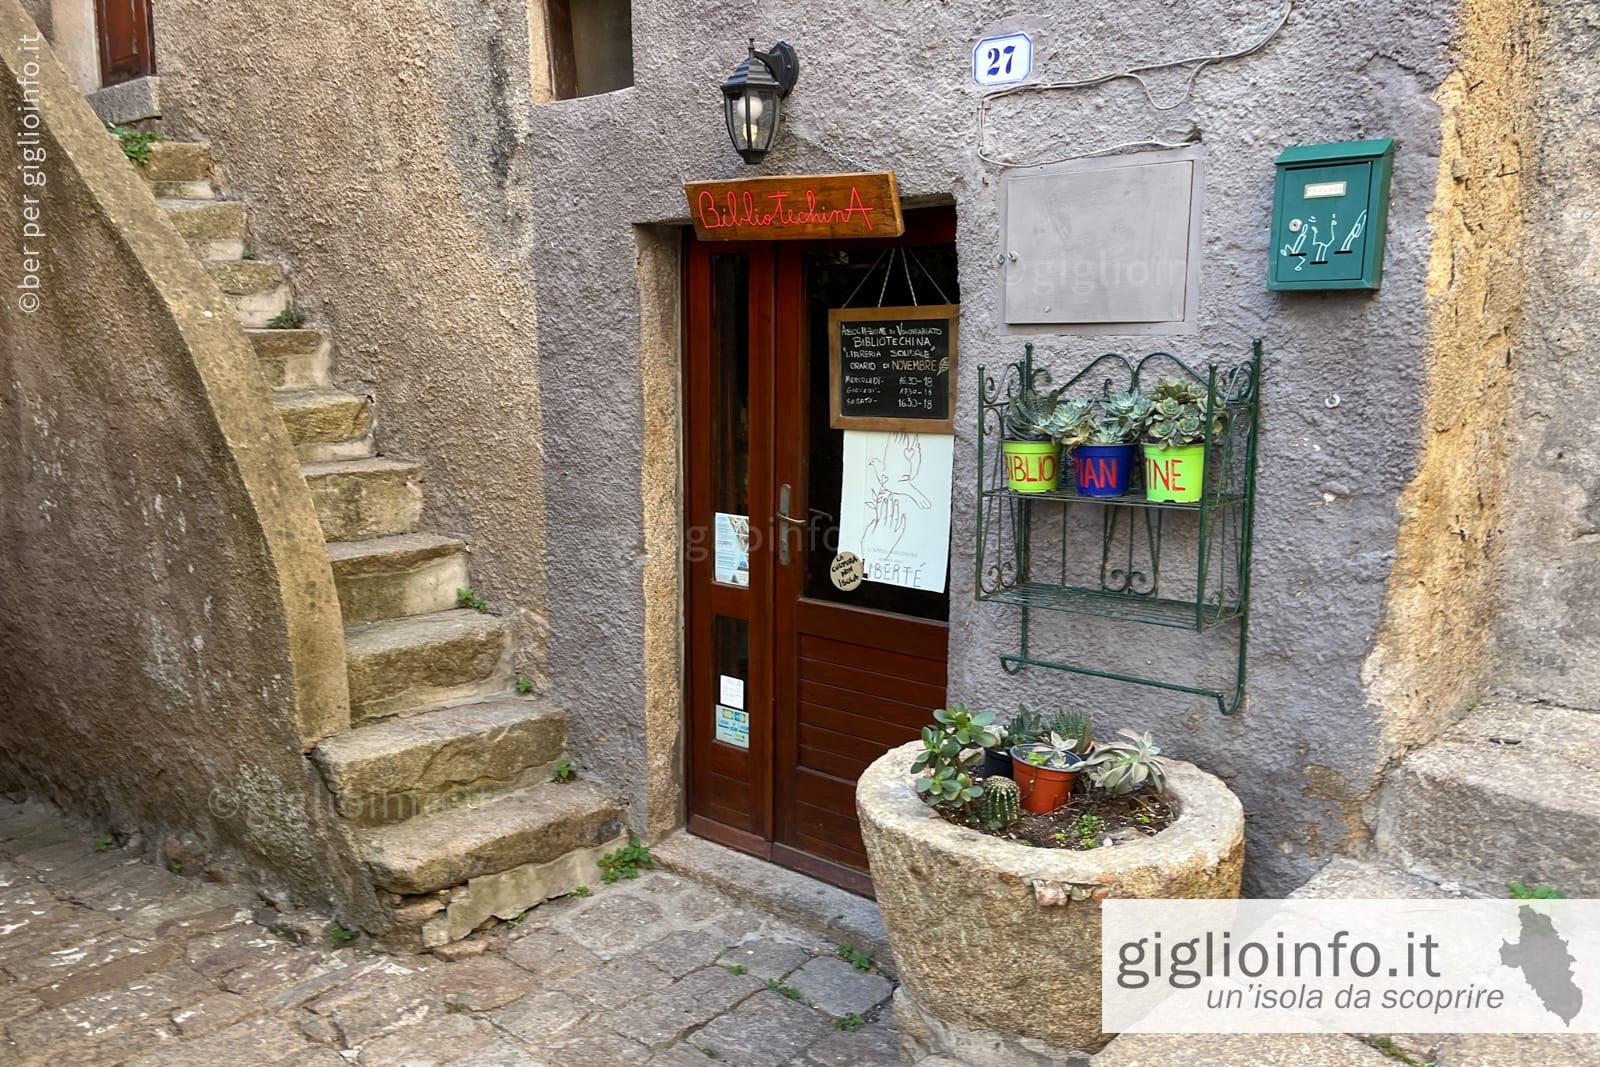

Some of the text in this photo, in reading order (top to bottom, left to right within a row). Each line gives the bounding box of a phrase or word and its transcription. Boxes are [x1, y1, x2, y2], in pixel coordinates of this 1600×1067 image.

[986, 45, 1016, 76] 27
[852, 336, 932, 348] BIBLIOTECHINA
[849, 362, 877, 371] ORARIO
[891, 359, 937, 371] NOVEMBRE
